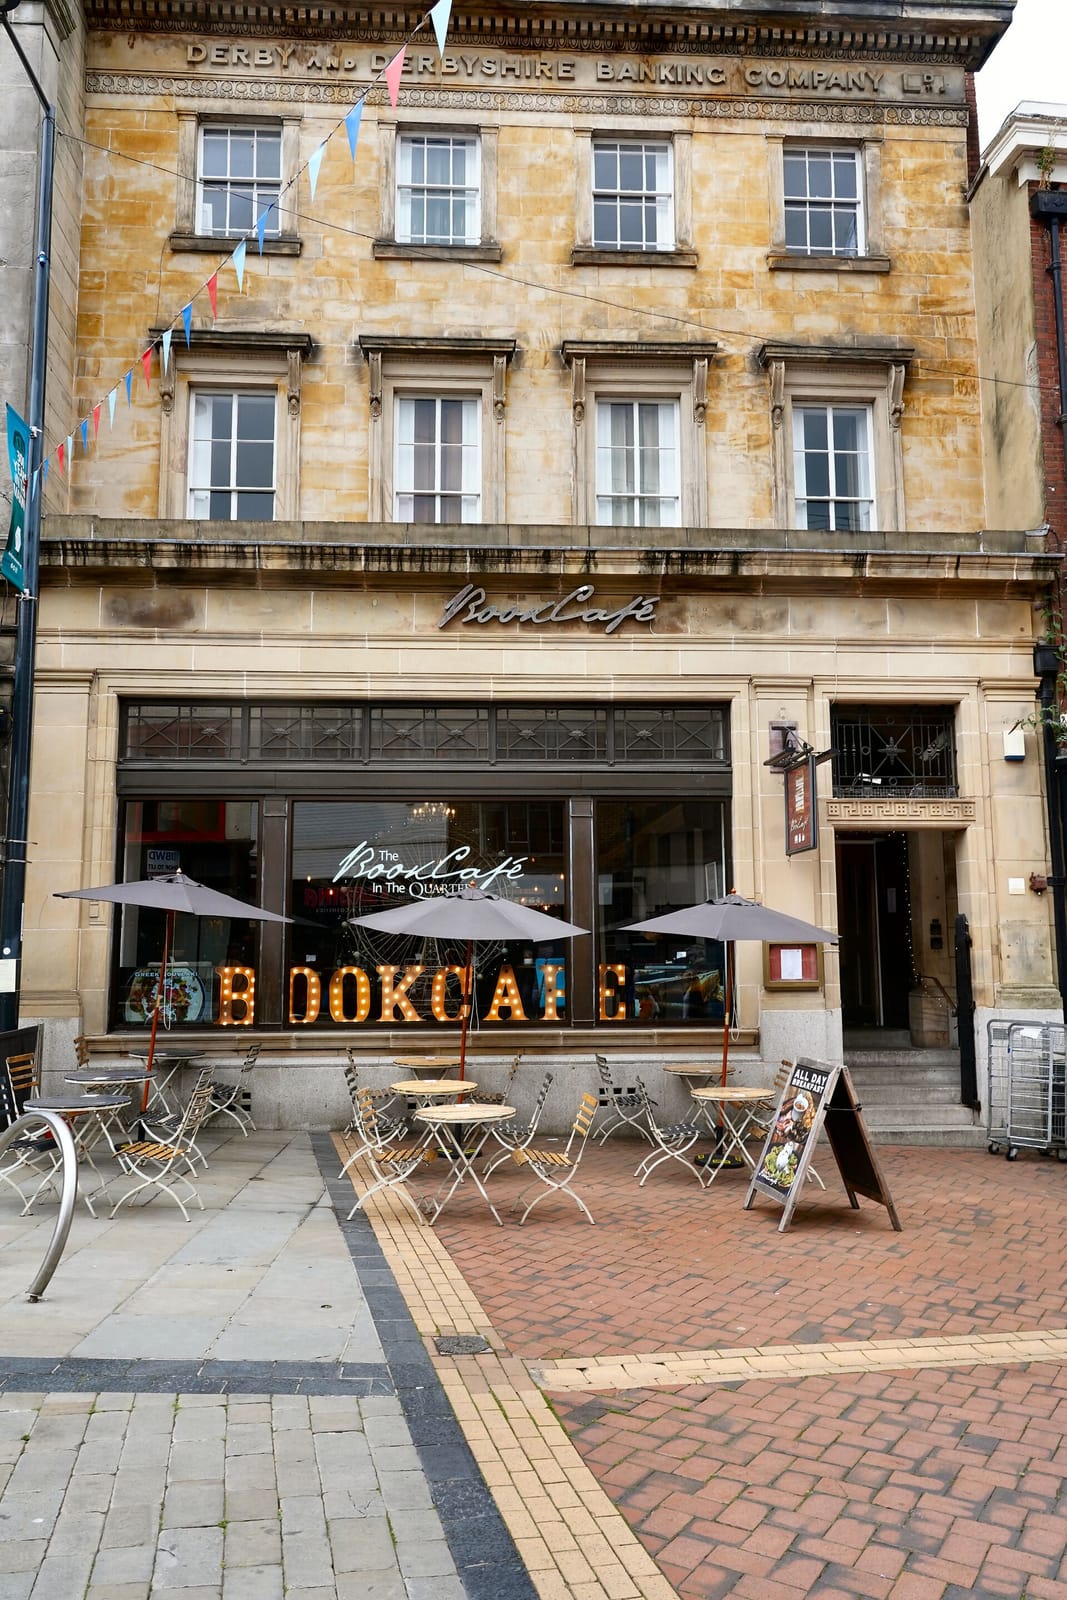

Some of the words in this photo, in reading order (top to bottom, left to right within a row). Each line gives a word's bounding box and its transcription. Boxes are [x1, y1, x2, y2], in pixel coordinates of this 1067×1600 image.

[186, 43, 294, 68] DERBY
[370, 53, 575, 81] DERBYSHIRE
[595, 60, 727, 86] BANKING
[744, 68, 884, 93] COMPANY
[379, 850, 399, 861] The
[372, 882, 383, 893] In
[385, 882, 405, 893] The
[408, 881, 470, 899] QUARTE
[793, 1068, 810, 1082] ALL
[811, 1072, 828, 1086] DAY
[791, 1078, 825, 1095] BREAKFAST
